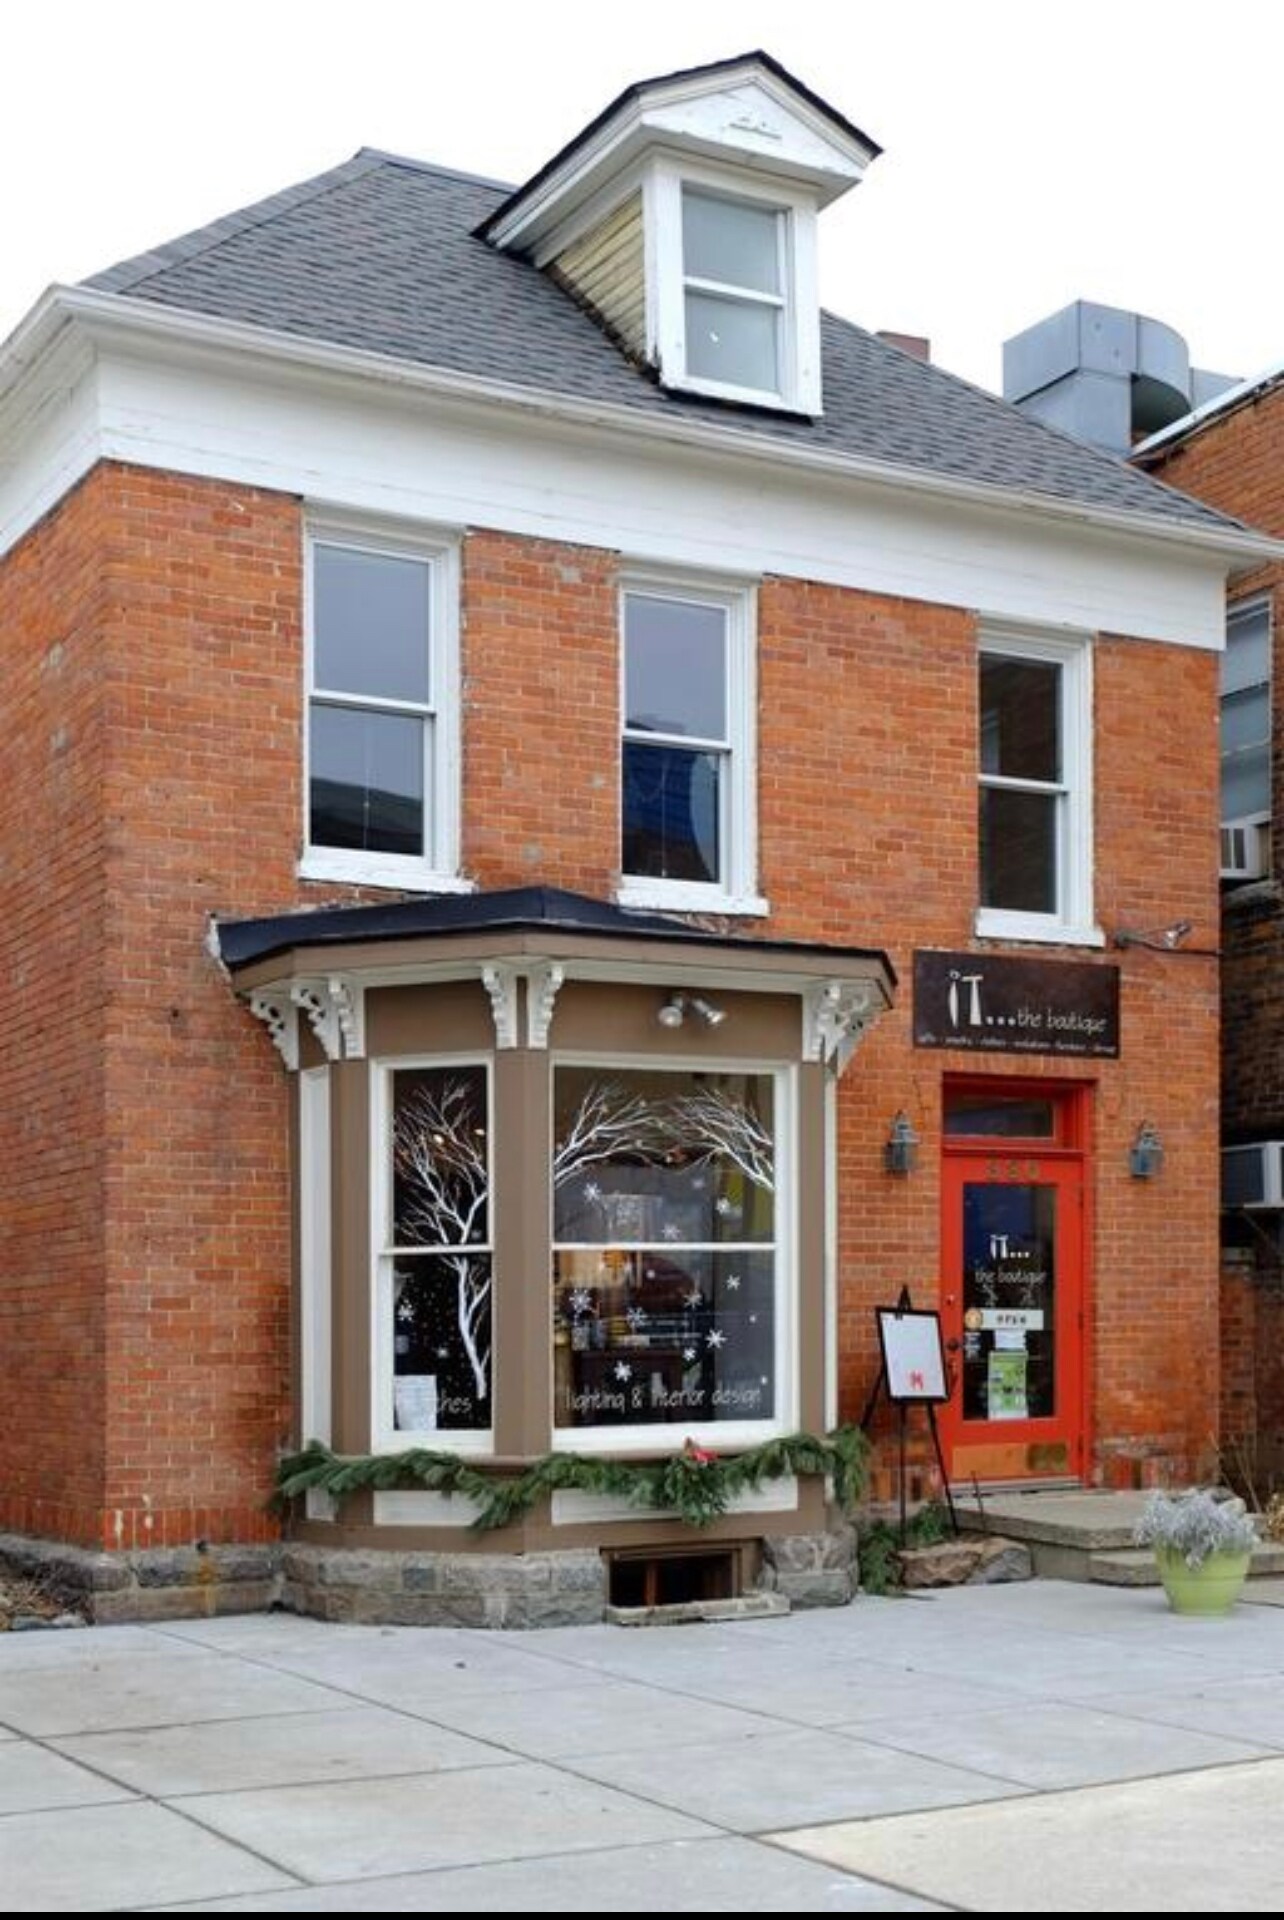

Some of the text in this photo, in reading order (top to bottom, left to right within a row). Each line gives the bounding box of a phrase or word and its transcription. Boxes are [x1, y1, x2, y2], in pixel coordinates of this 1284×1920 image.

[1017, 1007, 1042, 1028] the
[1047, 1008, 1107, 1036] boutique
[975, 1266, 1047, 1288] the boutique
[631, 1387, 643, 1409] &
